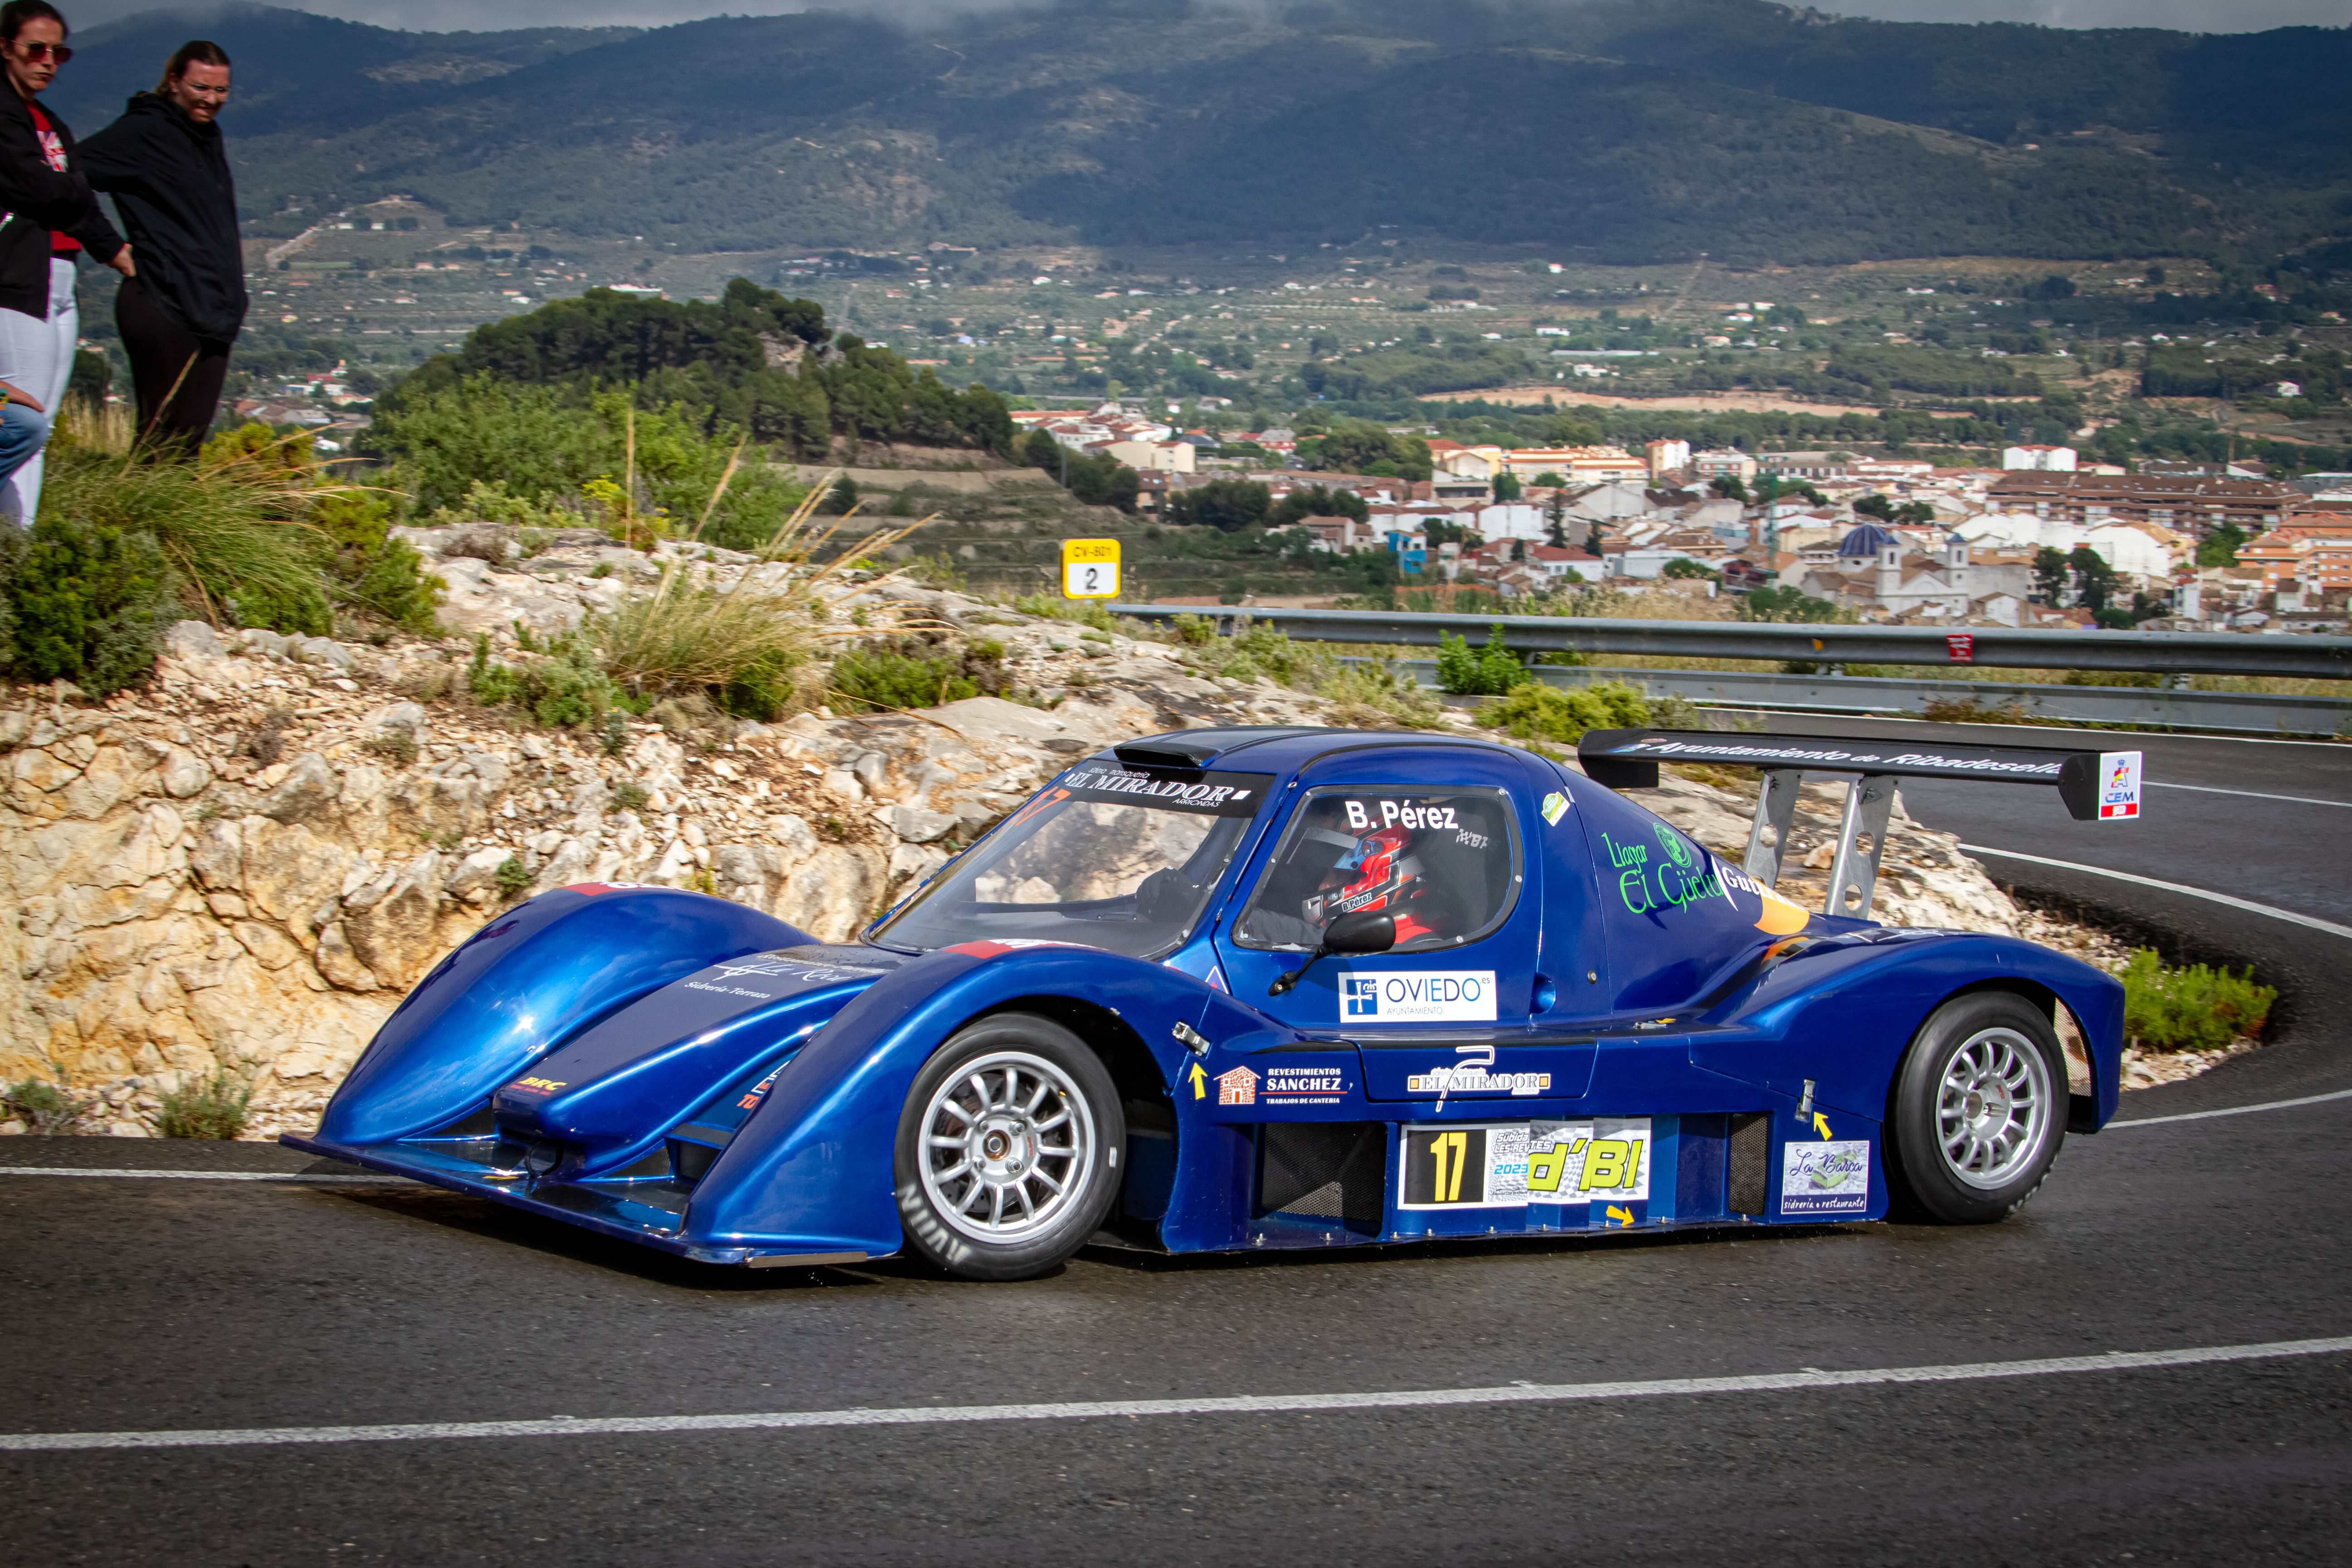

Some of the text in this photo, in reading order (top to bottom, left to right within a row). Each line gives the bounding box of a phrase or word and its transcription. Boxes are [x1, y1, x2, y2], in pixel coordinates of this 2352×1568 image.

[1085, 568, 1098, 590] 2
[1646, 742, 2062, 774] Ayuntamiento de Ribadesella
[1066, 772, 1234, 801] EL MIRADOR
[1172, 799, 1221, 807] ARRIONDAS
[2105, 791, 2134, 803] CEM
[1345, 800, 1459, 829] B. Pérez
[1601, 833, 1647, 874] Llagar
[1620, 868, 1657, 914] El
[1658, 862, 1724, 914] Güelu
[1386, 978, 1481, 1003] OVIEDO
[1387, 1006, 1443, 1015] AYUNTAMIENTO
[518, 1077, 568, 1091] BRC
[1267, 1078, 1341, 1091] SANCHEZ
[1421, 1075, 1538, 1089] EL MIRADOR
[1496, 1132, 1529, 1143] Subida
[1494, 1143, 1510, 1154] LES
[1430, 1132, 1467, 1202] 17
[1494, 1164, 1529, 1175] 2023
[1790, 1149, 1862, 1176] La Barca
[1784, 1196, 1864, 1209] sidrería restaurante
